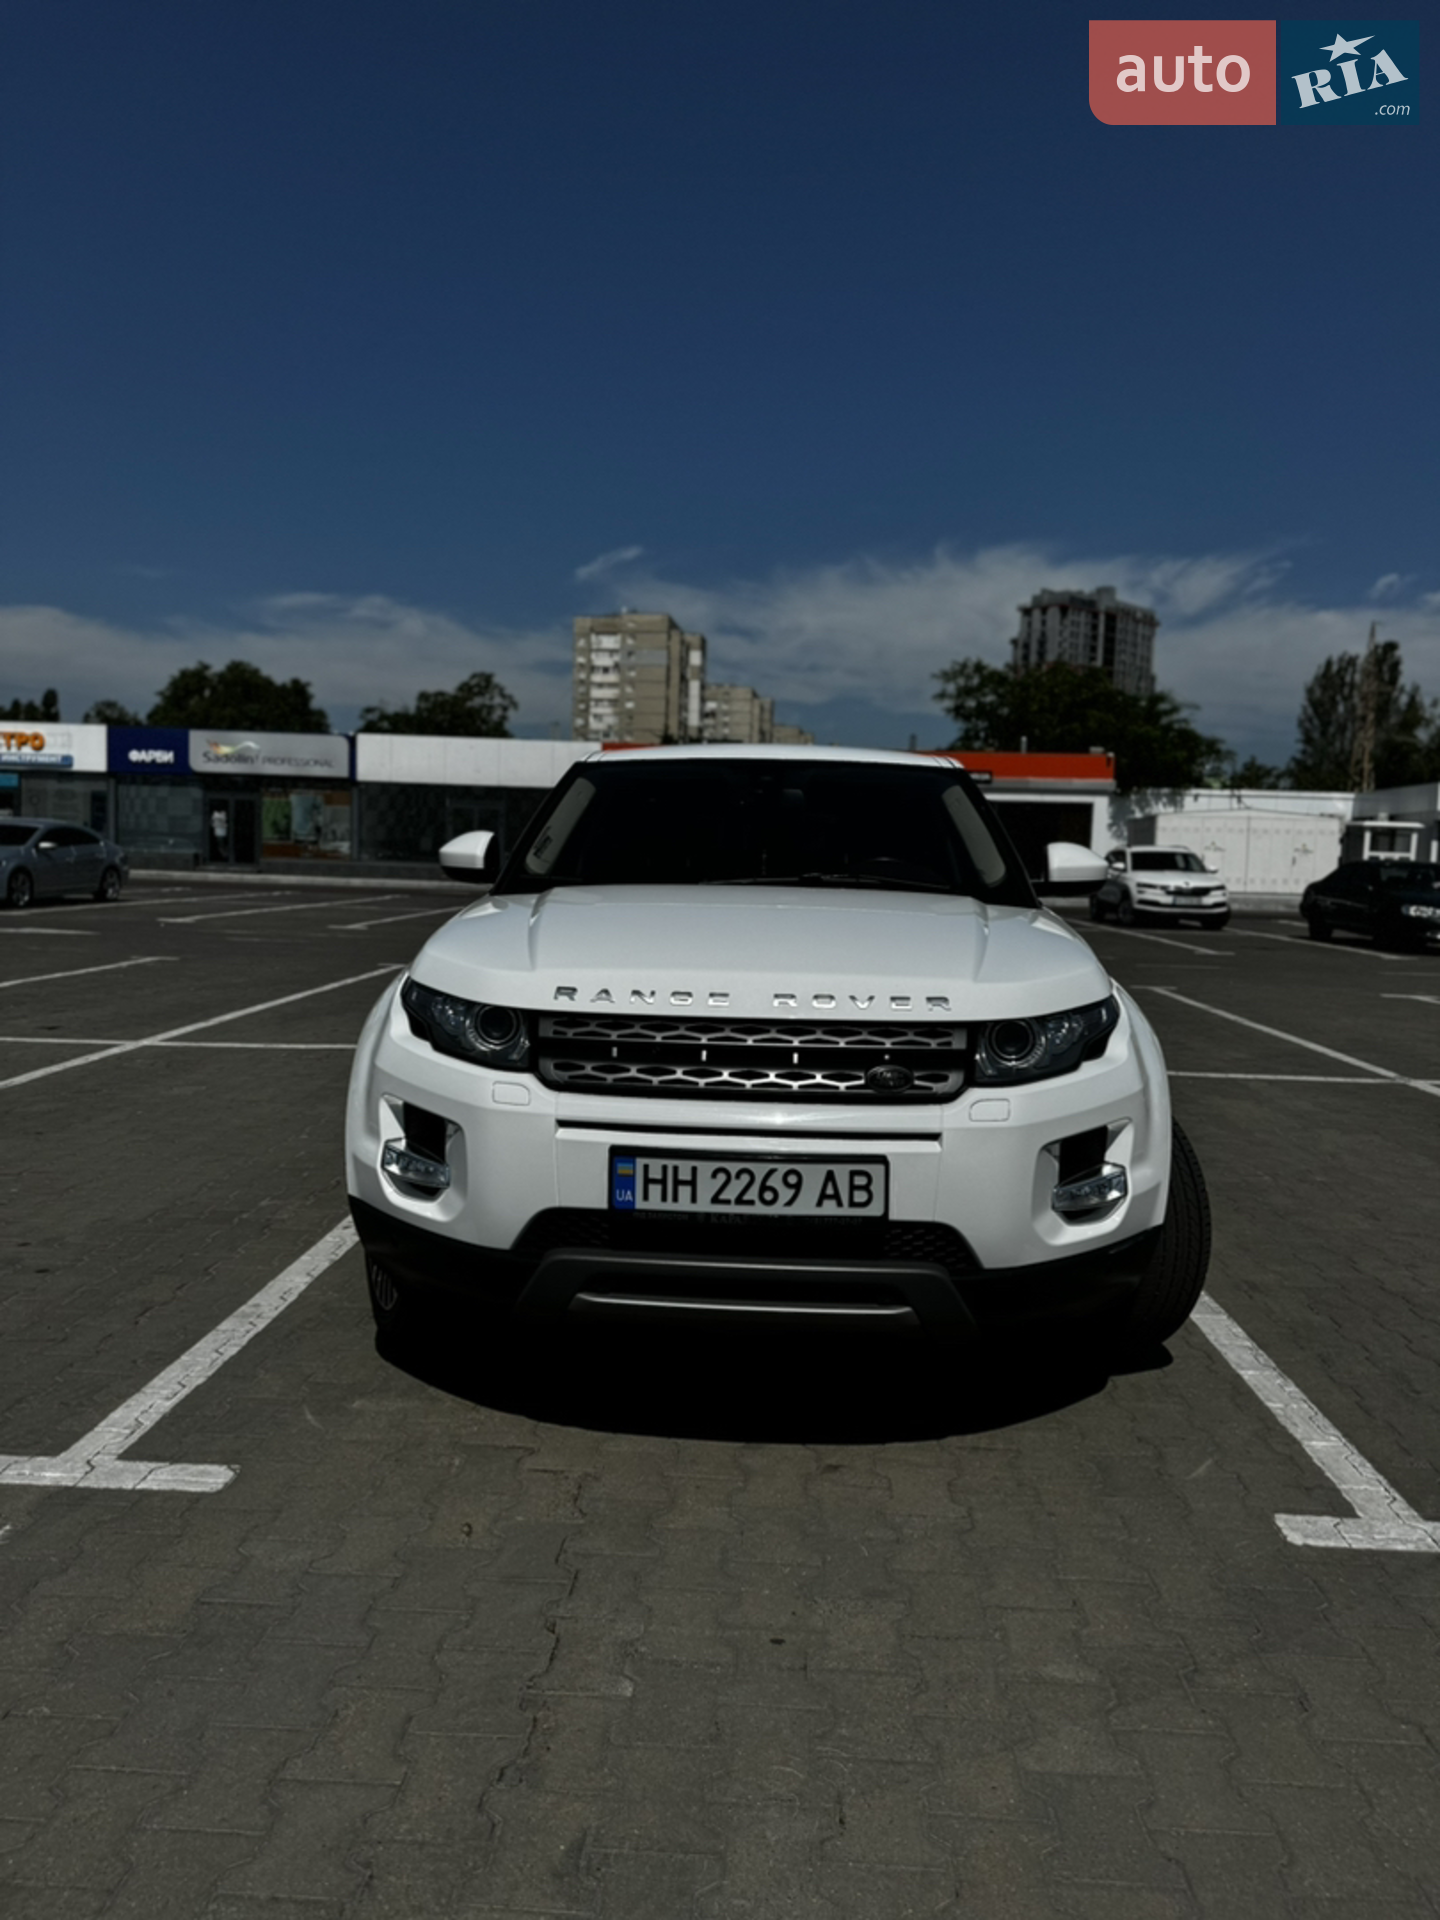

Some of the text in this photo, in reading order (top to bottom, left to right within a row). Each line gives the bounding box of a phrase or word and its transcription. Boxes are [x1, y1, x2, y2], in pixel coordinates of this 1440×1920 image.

[128, 749, 174, 763] ФАРБИ
[553, 985, 952, 1011] RANGE ROVER
[616, 1189, 633, 1202] UA
[642, 1163, 874, 1209] HH 2269 AB
